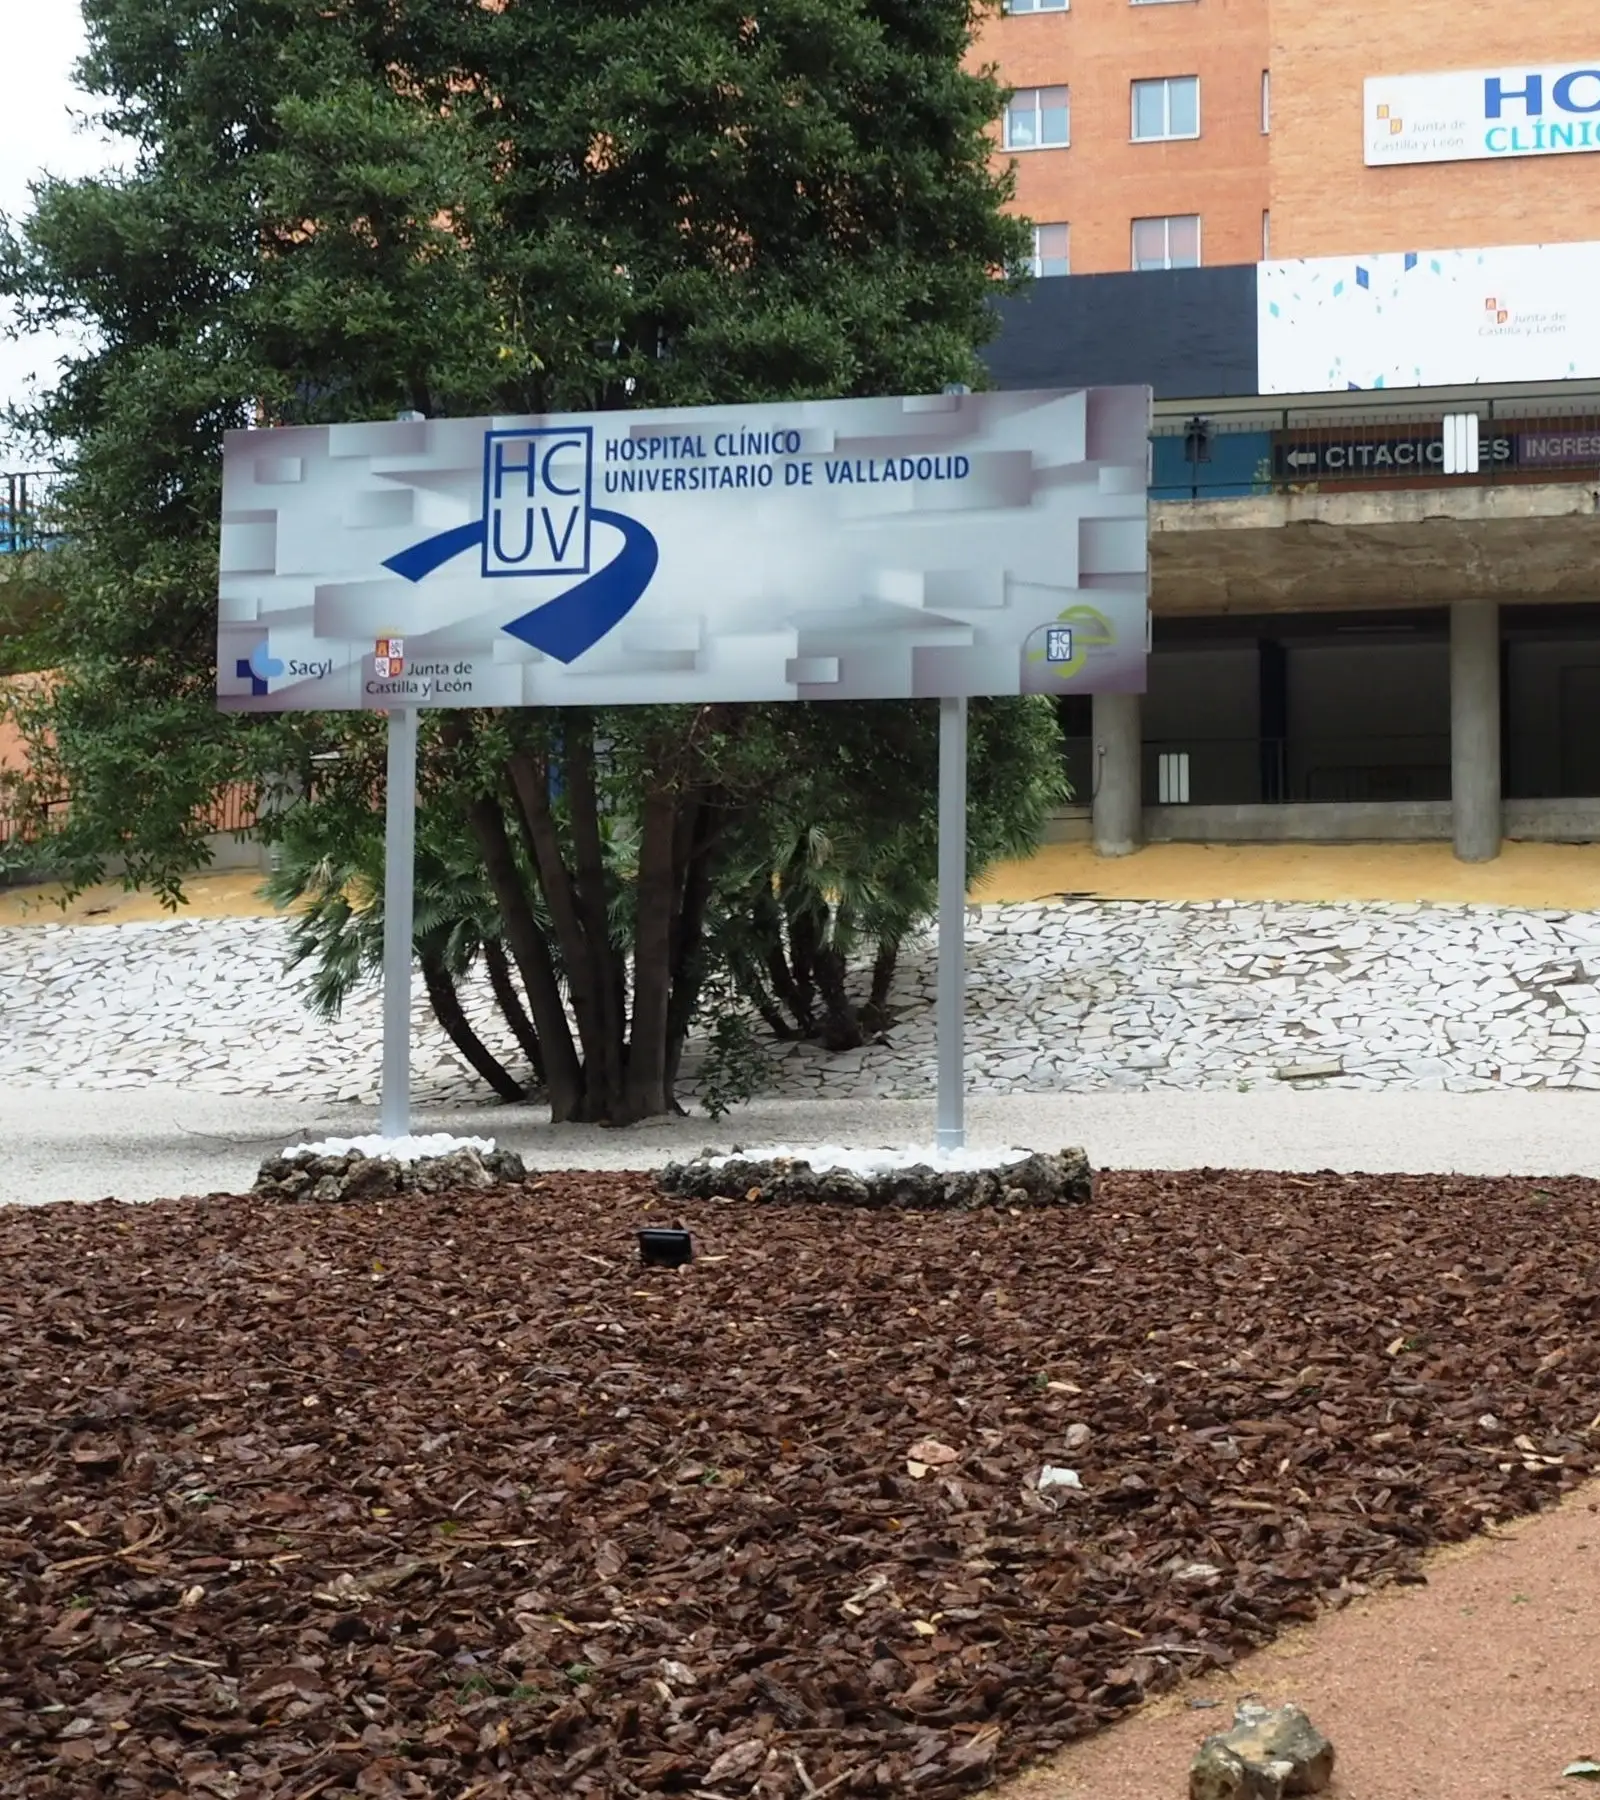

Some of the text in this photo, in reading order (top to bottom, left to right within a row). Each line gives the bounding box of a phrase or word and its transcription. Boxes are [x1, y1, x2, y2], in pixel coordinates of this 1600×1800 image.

[605, 426, 801, 462] HOSPITAL CLÍNICO
[1325, 439, 1510, 467] CITACIOES
[494, 440, 581, 499] HC
[605, 456, 970, 493] UNIVERSITARIO DE VALLADOLID
[493, 505, 580, 564] UV
[1049, 632, 1069, 645] HC
[1049, 646, 1069, 659] UV
[288, 659, 332, 679] Sacyl
[407, 661, 472, 676] Junta de
[366, 679, 472, 697] Castilla y León
